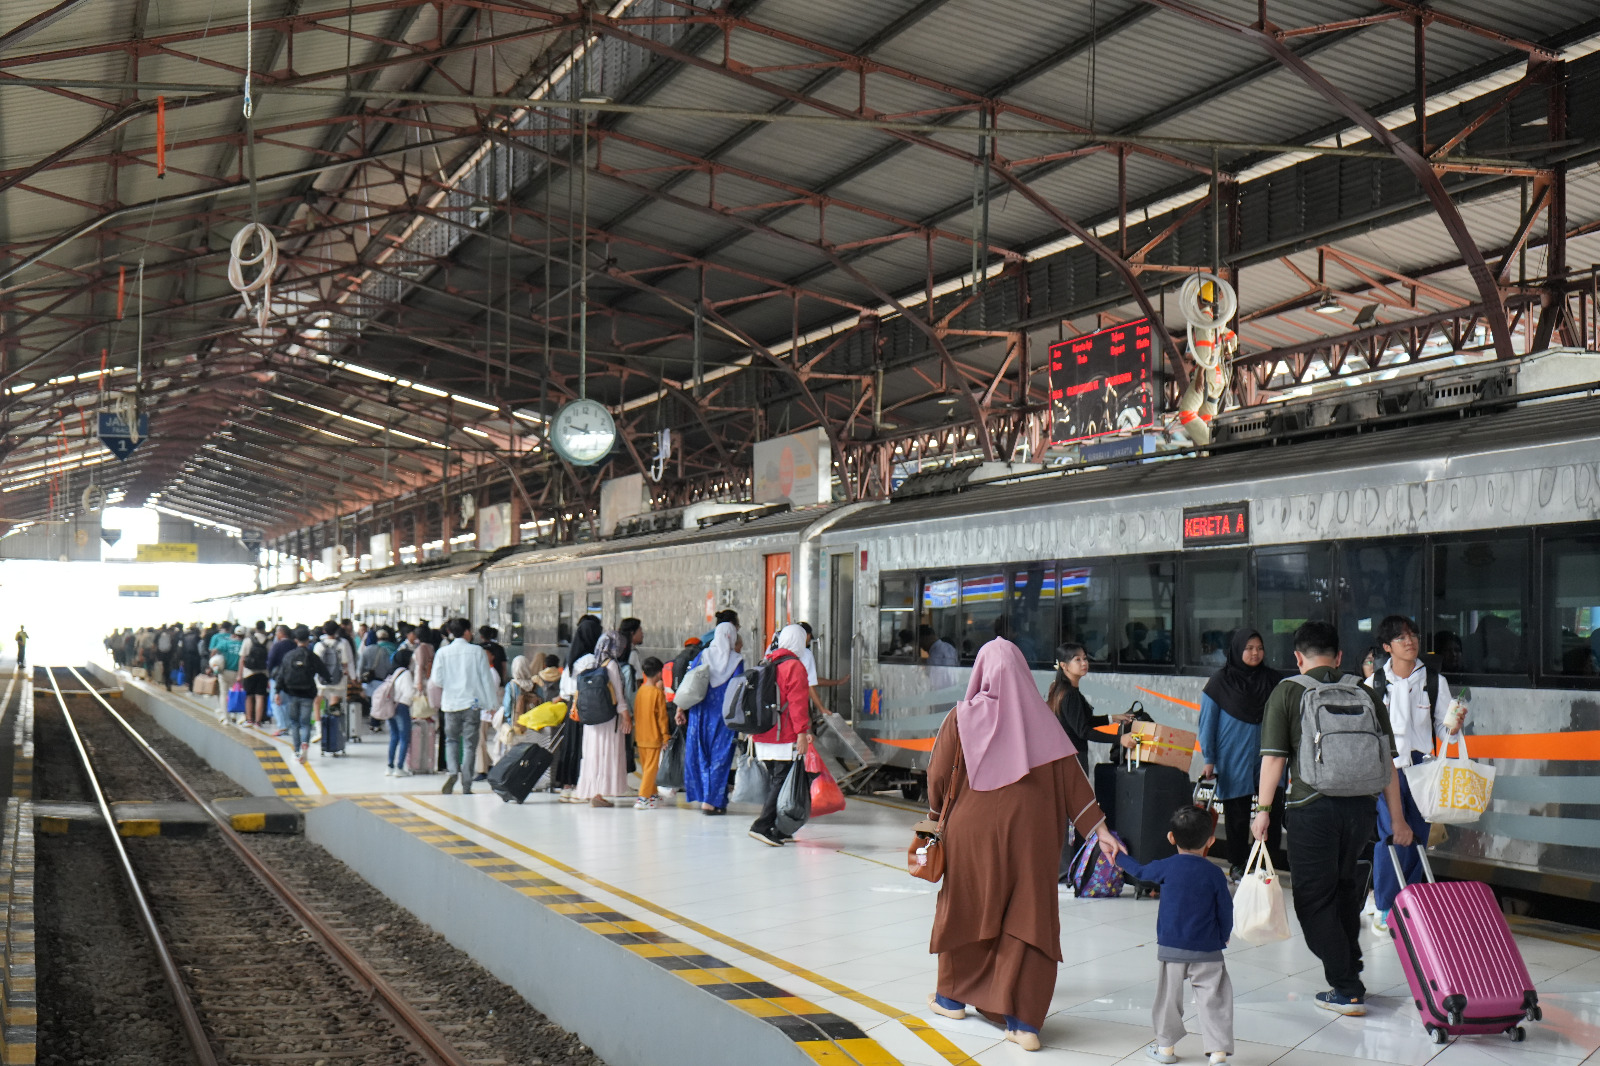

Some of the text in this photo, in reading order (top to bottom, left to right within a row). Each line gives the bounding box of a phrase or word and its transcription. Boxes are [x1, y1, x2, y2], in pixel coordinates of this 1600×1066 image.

[118, 439, 128, 452] 1
[1184, 513, 1245, 538] KERETA A
[1438, 766, 1451, 808] HokBen
[1454, 792, 1486, 811] BOX
